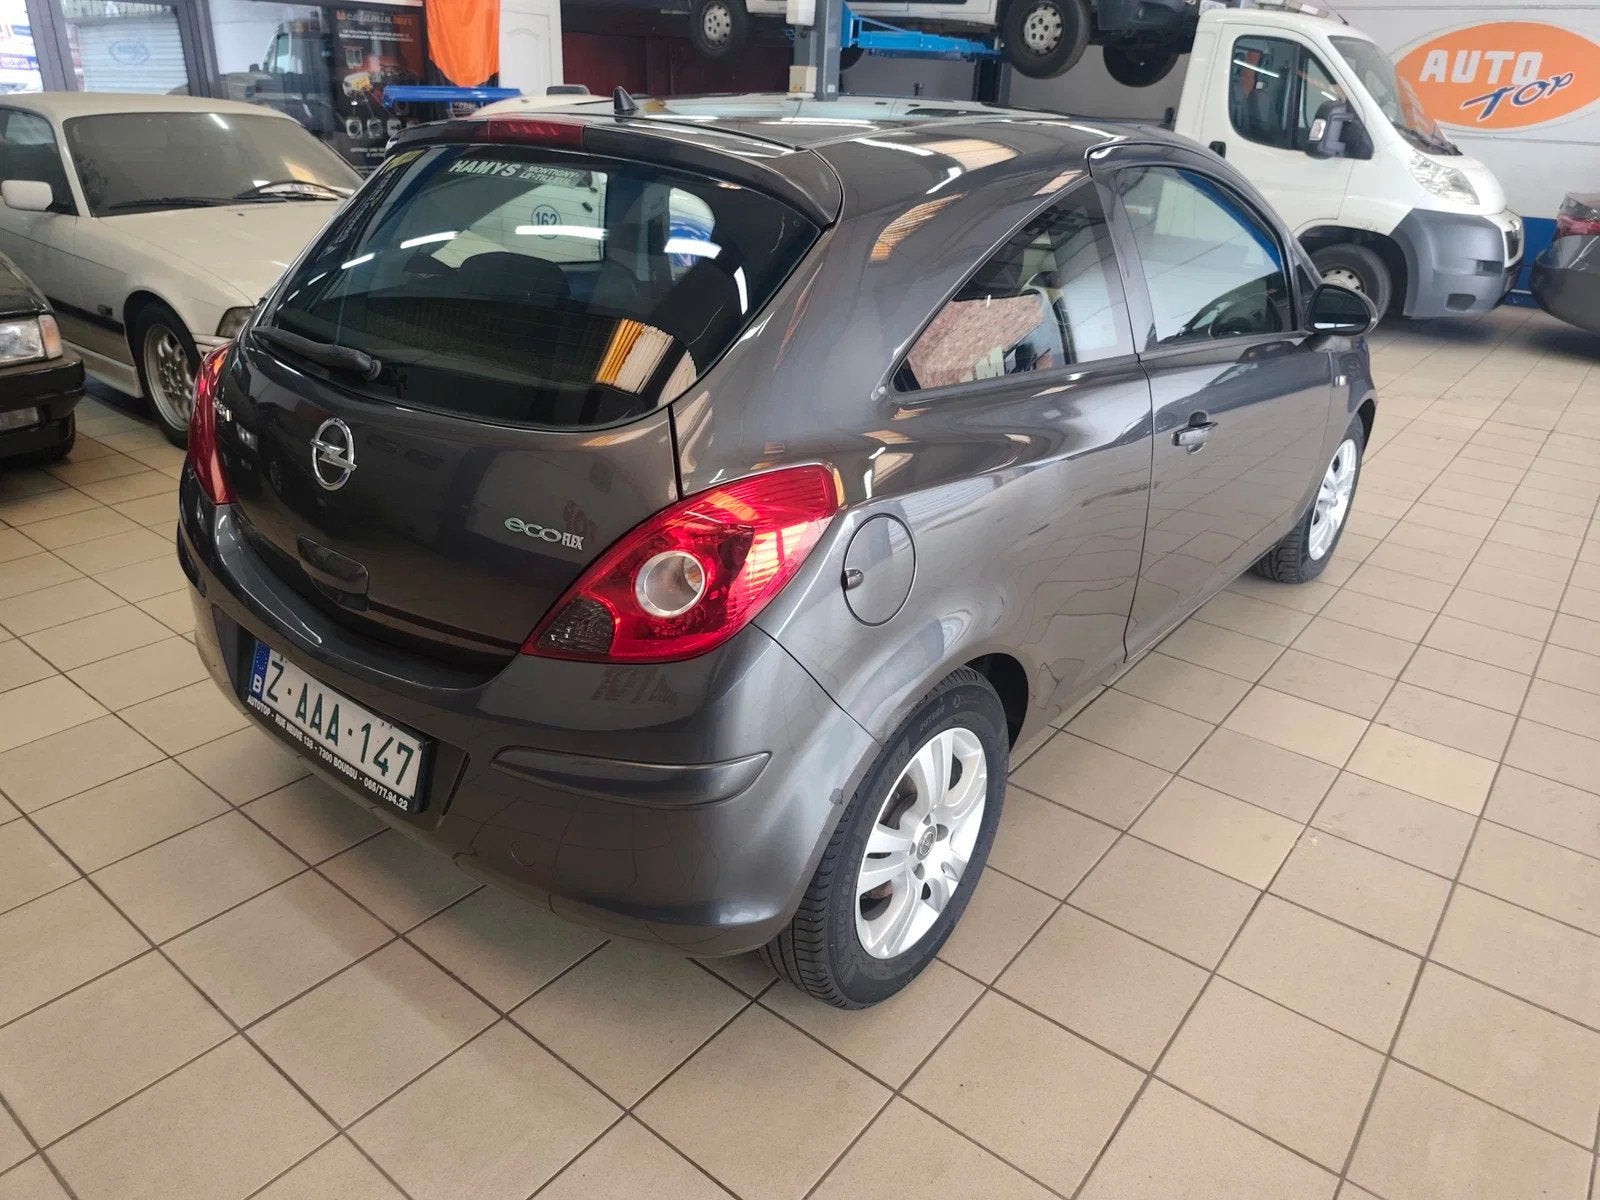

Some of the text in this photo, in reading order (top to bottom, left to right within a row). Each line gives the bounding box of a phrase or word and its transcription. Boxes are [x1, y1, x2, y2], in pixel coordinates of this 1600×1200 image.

[1419, 49, 1543, 85] AUTO
[448, 160, 521, 177] HAMYS
[252, 673, 263, 694] B
[333, 756, 359, 780] BOUSSU
